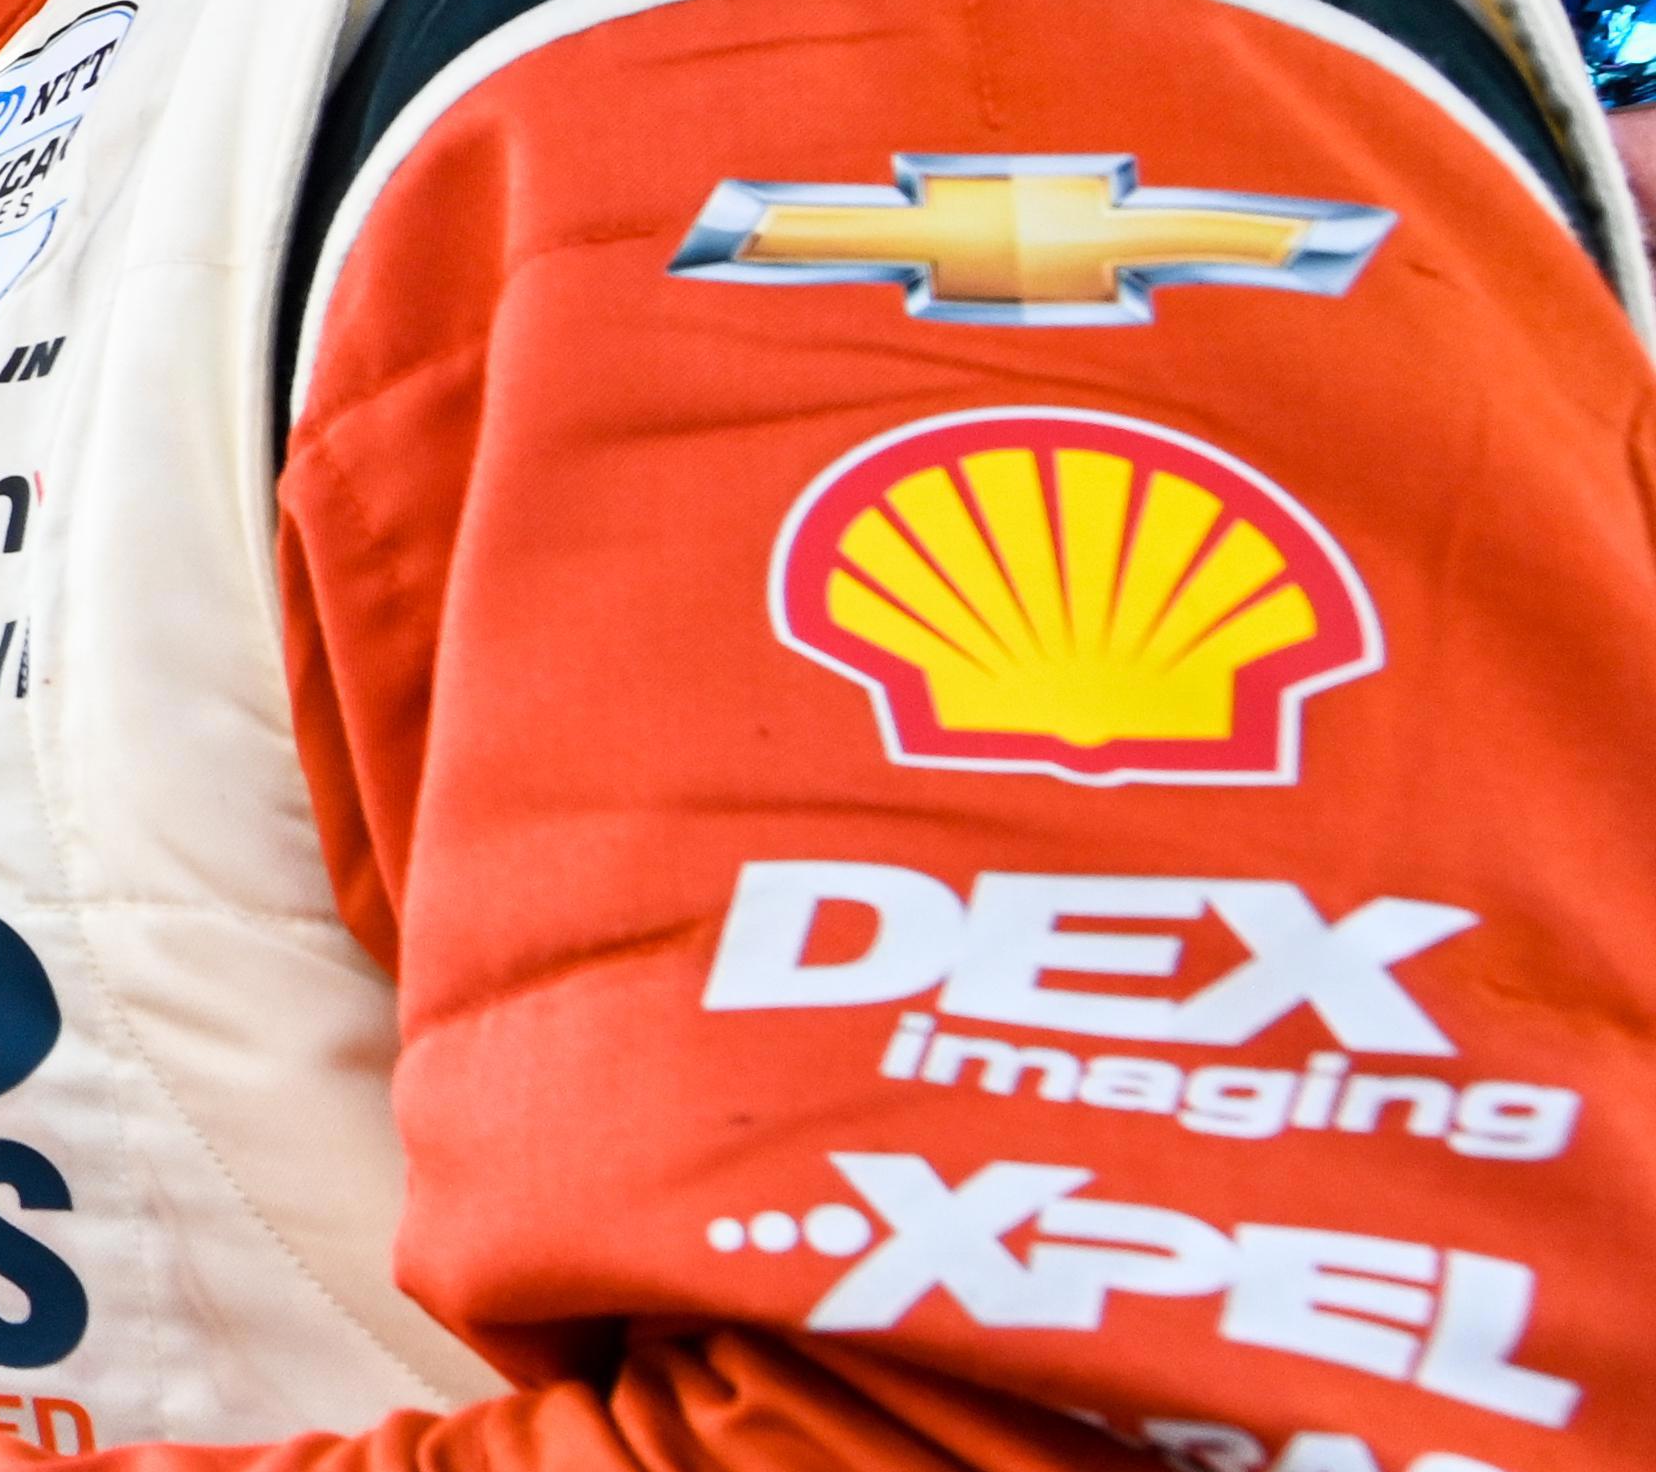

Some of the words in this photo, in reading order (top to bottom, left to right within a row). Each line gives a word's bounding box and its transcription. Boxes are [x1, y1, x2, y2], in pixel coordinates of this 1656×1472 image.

[21, 38, 118, 125] NTT
[701, 858, 1481, 1057] DEX
[879, 1012, 1581, 1162] imaging
[804, 1150, 1584, 1431] XPEL
